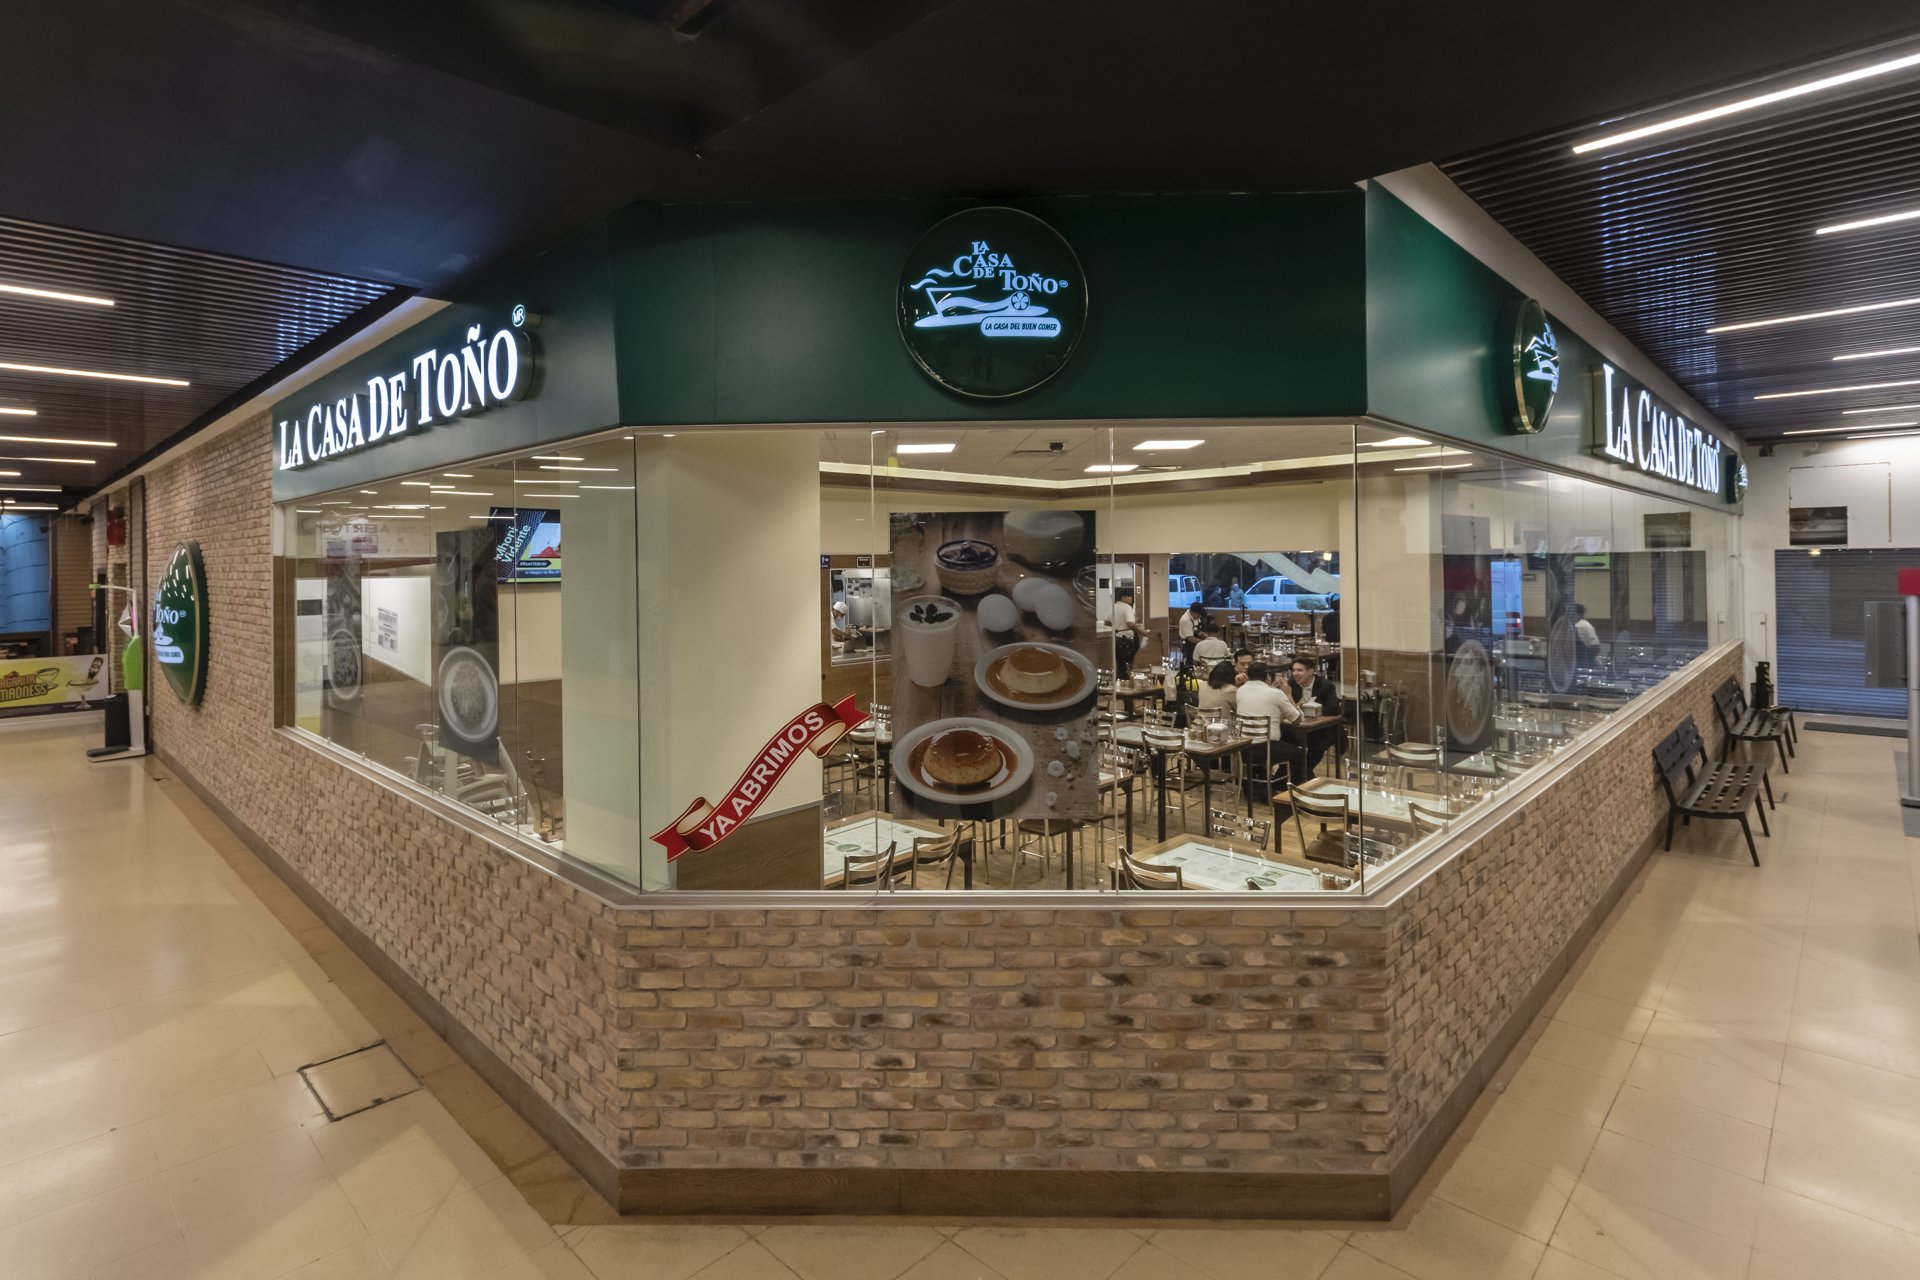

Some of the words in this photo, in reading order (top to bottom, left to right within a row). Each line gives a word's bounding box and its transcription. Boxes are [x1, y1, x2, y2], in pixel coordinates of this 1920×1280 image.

[953, 253, 1014, 277] CASA
[972, 241, 990, 255] LA
[973, 267, 995, 279] DE
[999, 269, 1059, 294] TOÑO
[279, 420, 304, 470] LA
[307, 393, 365, 461] CASA
[367, 372, 408, 442] DE
[413, 323, 518, 425] TOÑO
[1603, 363, 1634, 464] LA
[1637, 389, 1677, 480] CASA
[1677, 416, 1695, 486] DE
[1694, 427, 1720, 494] TOÑO
[496, 526, 518, 560] Mhoni
[699, 814, 736, 842] YA
[731, 711, 824, 818] ABRIMOS
